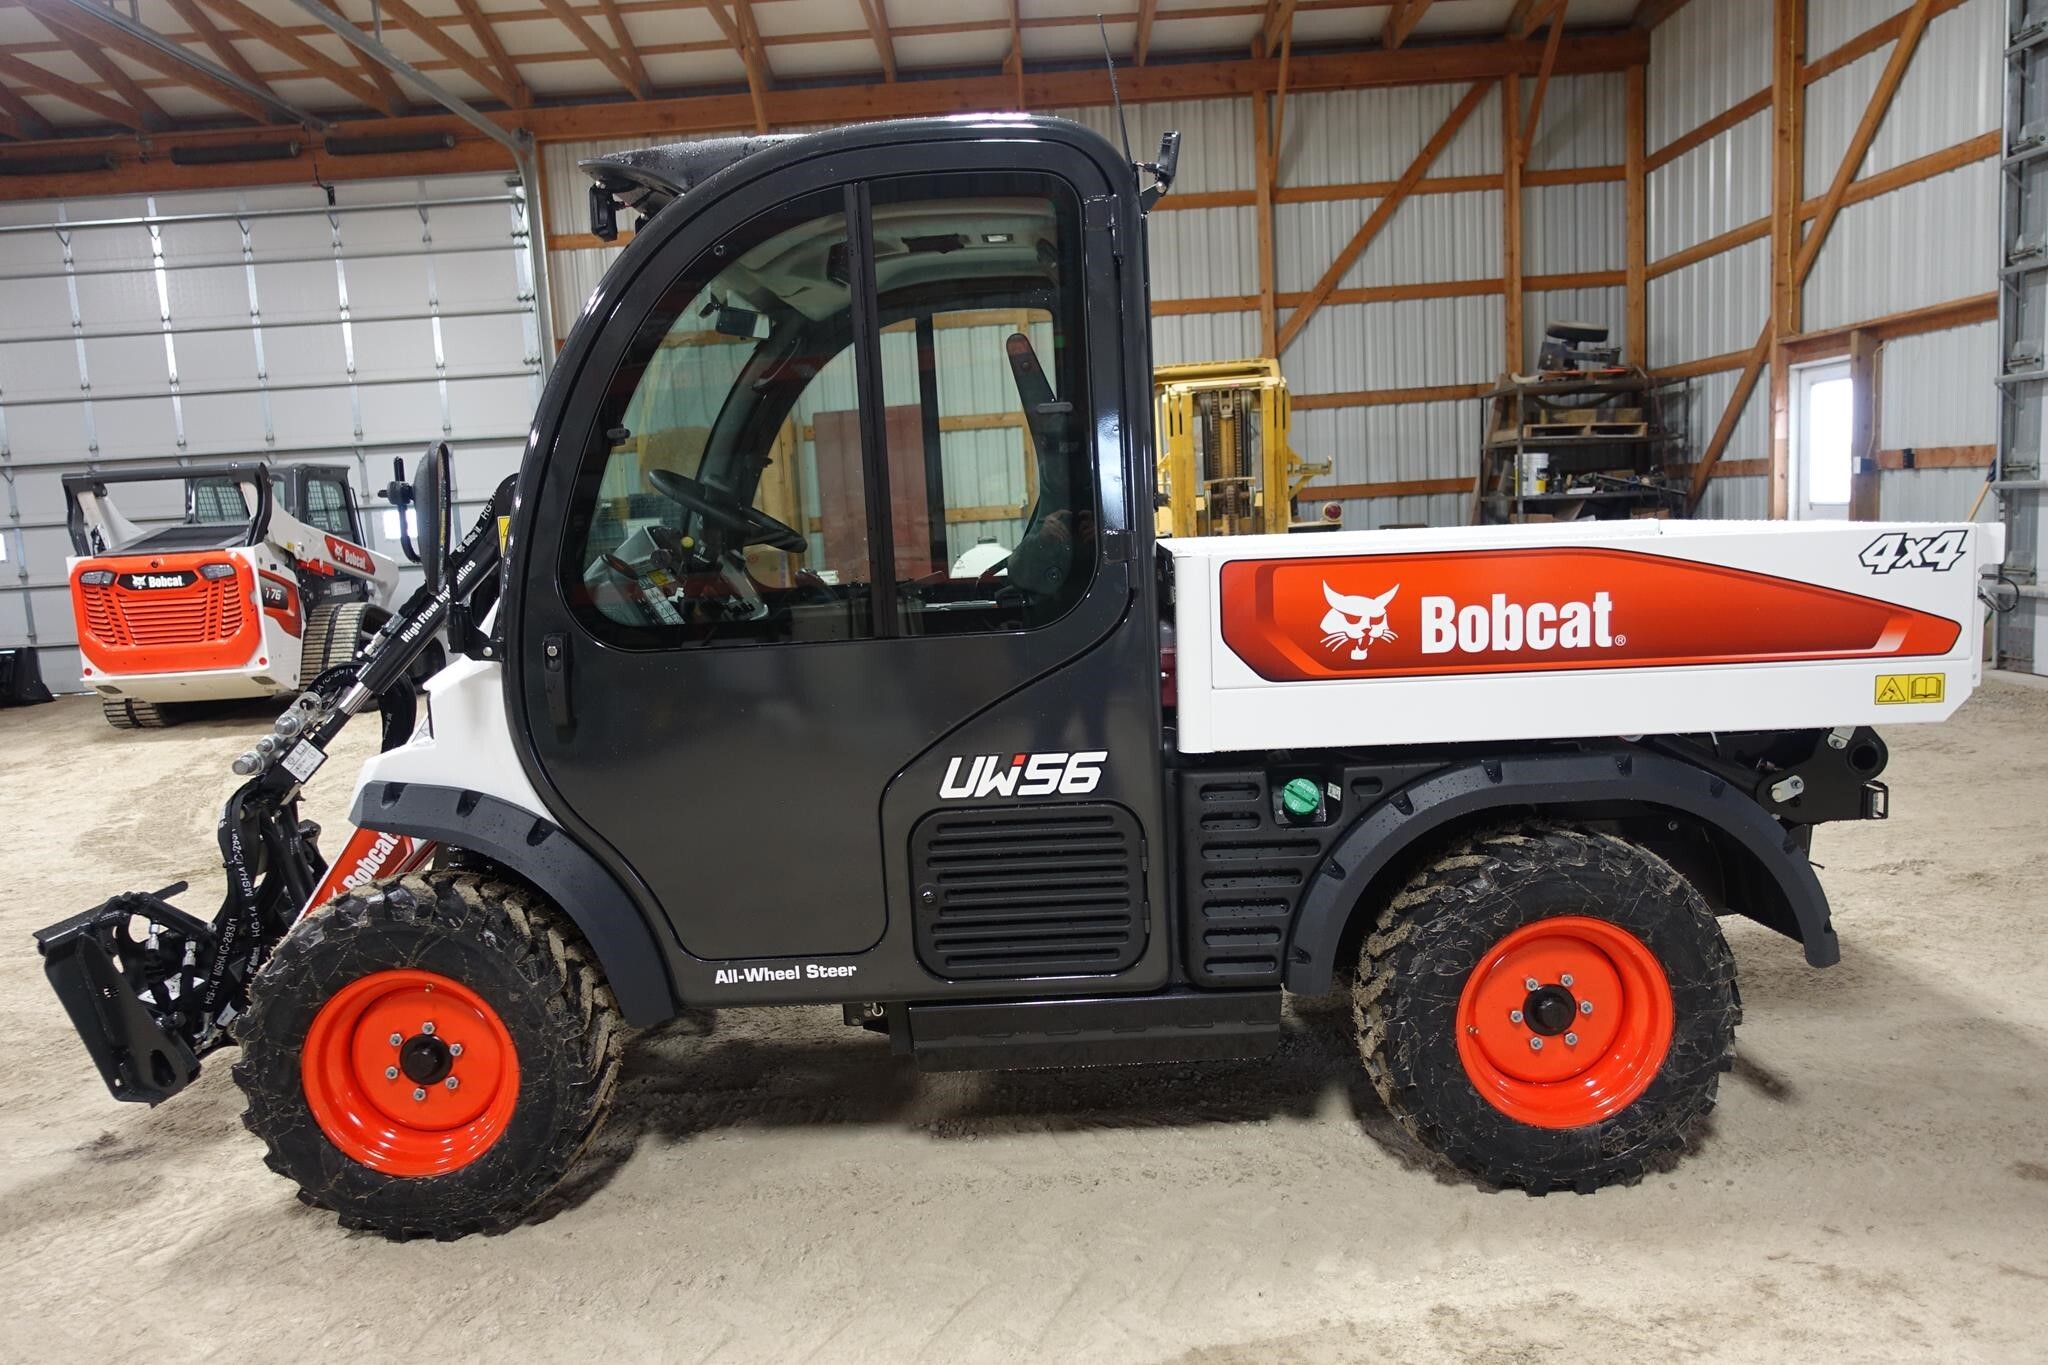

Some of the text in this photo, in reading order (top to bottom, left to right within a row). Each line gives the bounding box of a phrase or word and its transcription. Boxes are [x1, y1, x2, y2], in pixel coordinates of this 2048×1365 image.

[1858, 530, 1969, 575] 4x4
[149, 574, 184, 588] Bobcat
[400, 622, 423, 643] High
[418, 600, 440, 624] Flow
[1421, 591, 1613, 654] Bobcat
[937, 751, 1108, 799] UW56
[238, 867, 254, 897] MSHA
[341, 831, 400, 890] Bobcat
[248, 905, 261, 938] HG-14
[714, 964, 858, 985] All-Wheel Steer
